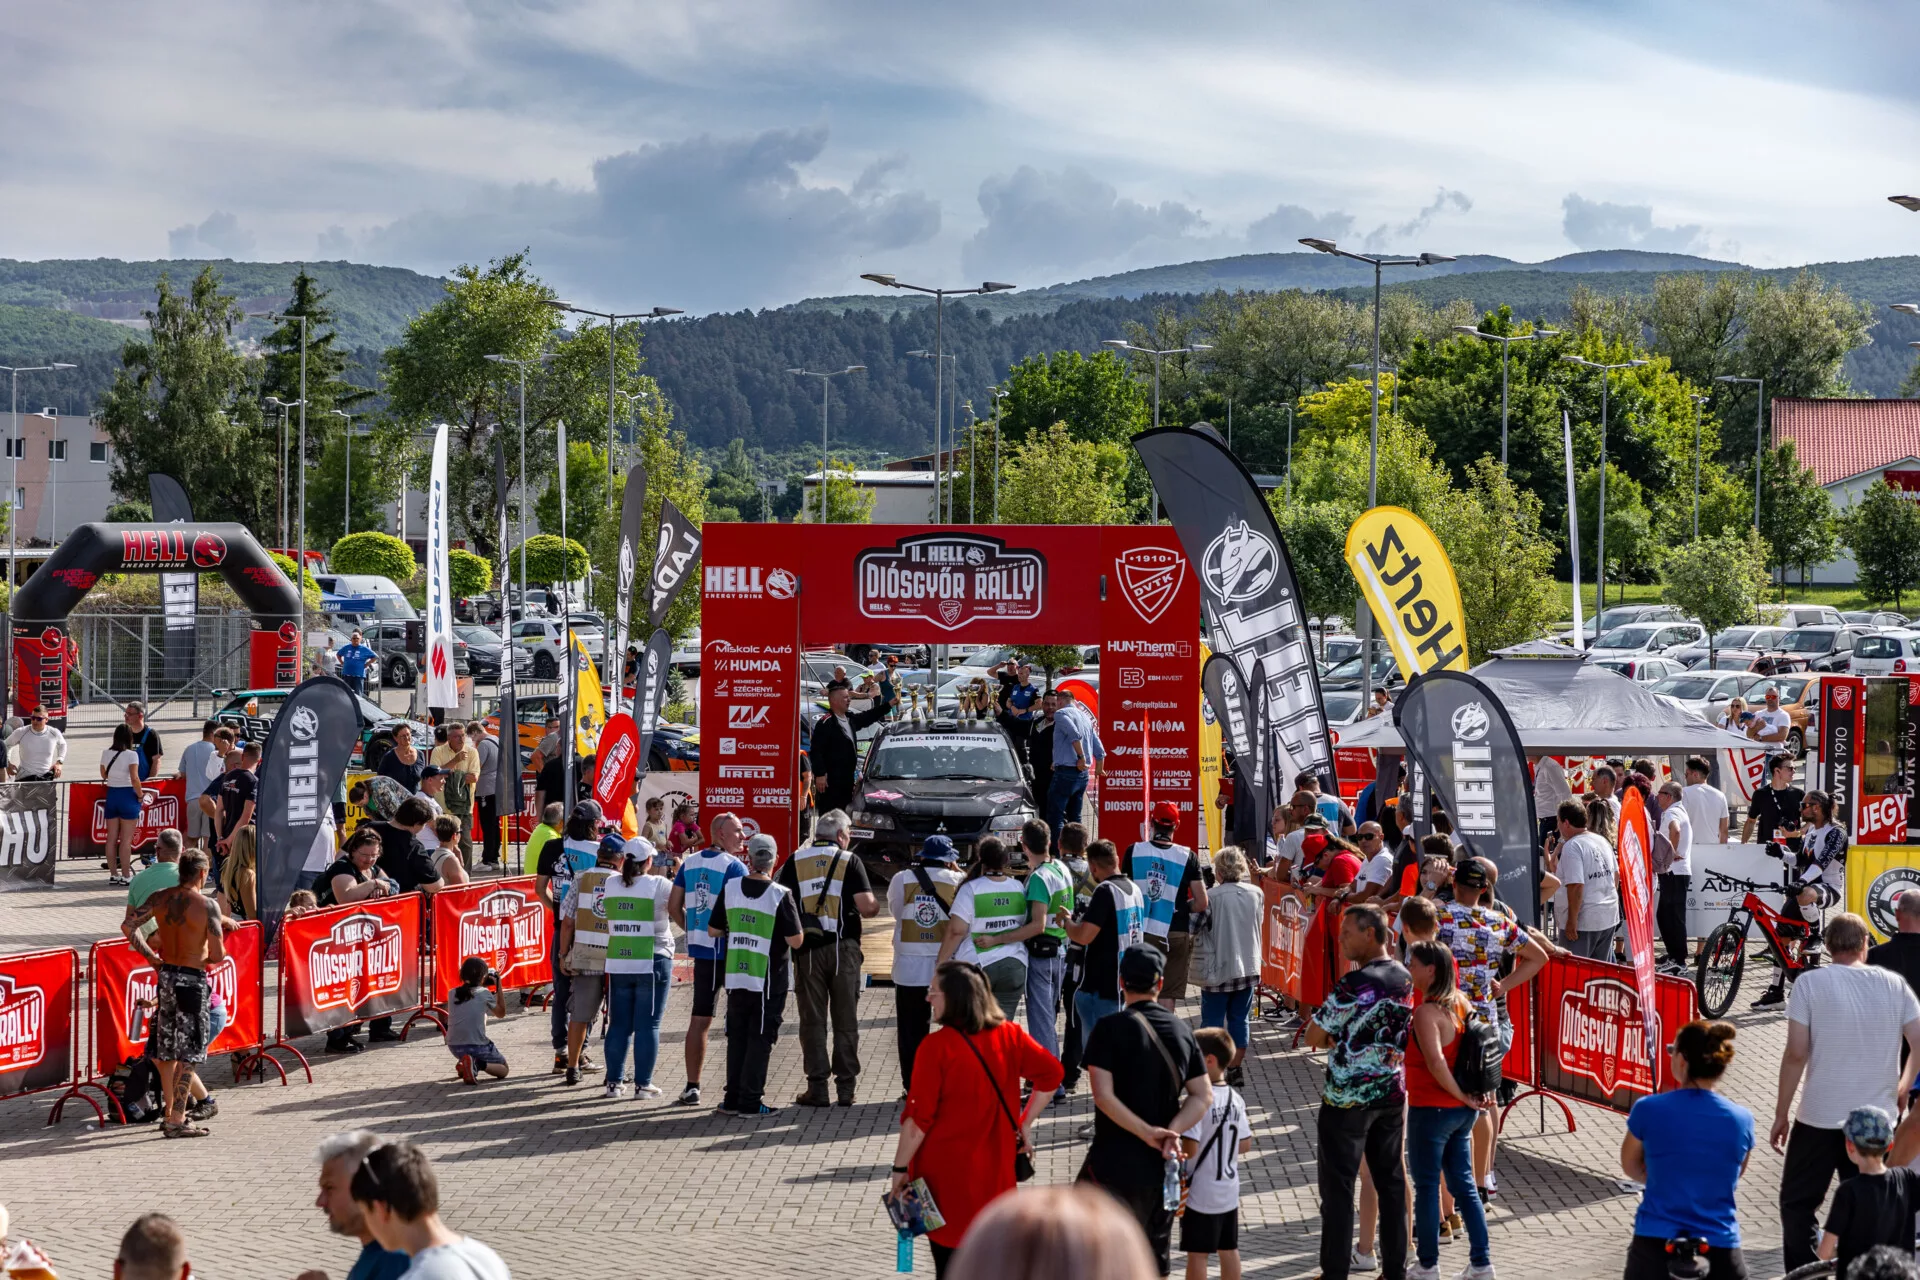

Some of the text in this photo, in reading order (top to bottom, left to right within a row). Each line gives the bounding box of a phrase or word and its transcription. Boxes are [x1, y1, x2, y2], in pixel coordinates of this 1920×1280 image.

[121, 530, 189, 562] HELL
[433, 480, 443, 634] SUZUKI
[928, 545, 965, 562] HELL
[704, 566, 763, 593] HELL
[866, 561, 1035, 600] DIÓSGYŐR RALLY
[1133, 573, 1174, 597] DVTK
[715, 644, 792, 654] Miskolc Autó
[1107, 640, 1176, 652] HUN-Therm
[730, 659, 782, 672] HUMDA
[40, 653, 63, 710] HELL
[733, 685, 773, 693] SZÉCHENYI
[247, 703, 257, 716] 10
[737, 741, 780, 751] Groupama
[942, 735, 998, 743] MOTORSPORT
[1834, 726, 1848, 758] 1910
[287, 740, 319, 822] HELL
[718, 765, 775, 779] PIRELLI
[1153, 778, 1192, 787] HIST
[1834, 762, 1847, 805] DVTK
[706, 794, 745, 804] ORB2
[147, 802, 175, 828] RALLY
[1859, 794, 1908, 836] JEGY
[1869, 873, 1897, 908] MAGYAR
[618, 902, 634, 910] 2024
[513, 911, 541, 949] RALLY
[985, 919, 1017, 930] PHOTO/TV
[368, 934, 399, 977] RALLY
[1598, 988, 1620, 1011] HELL
[1562, 1000, 1618, 1057] DIÓSGYŐR
